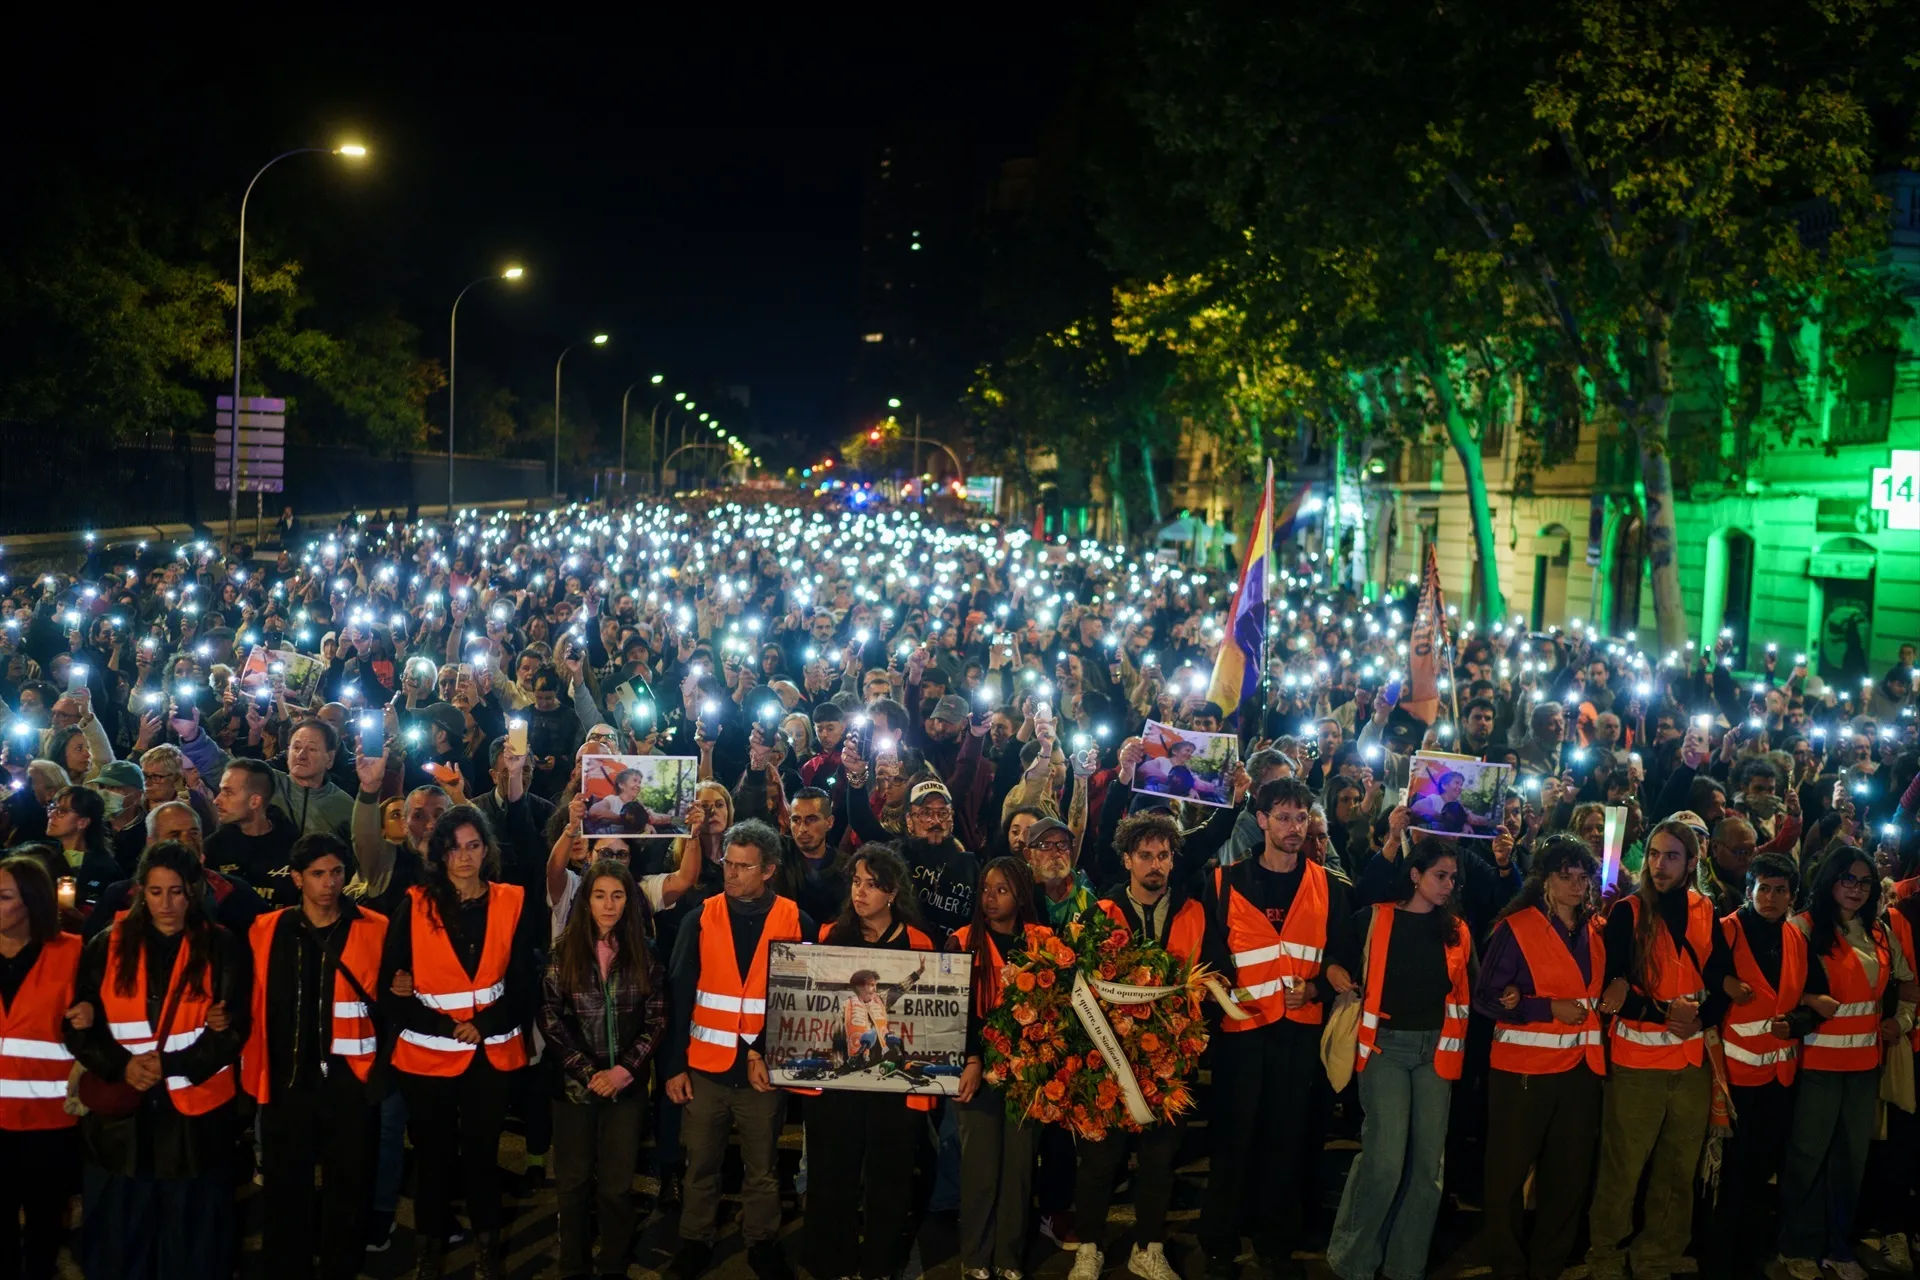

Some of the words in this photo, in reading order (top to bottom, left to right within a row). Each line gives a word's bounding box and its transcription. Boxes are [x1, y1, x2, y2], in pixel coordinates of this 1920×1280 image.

[1074, 986, 1083, 998] Te
[807, 995, 840, 1013] VIDA
[904, 999, 959, 1017] BARRIO
